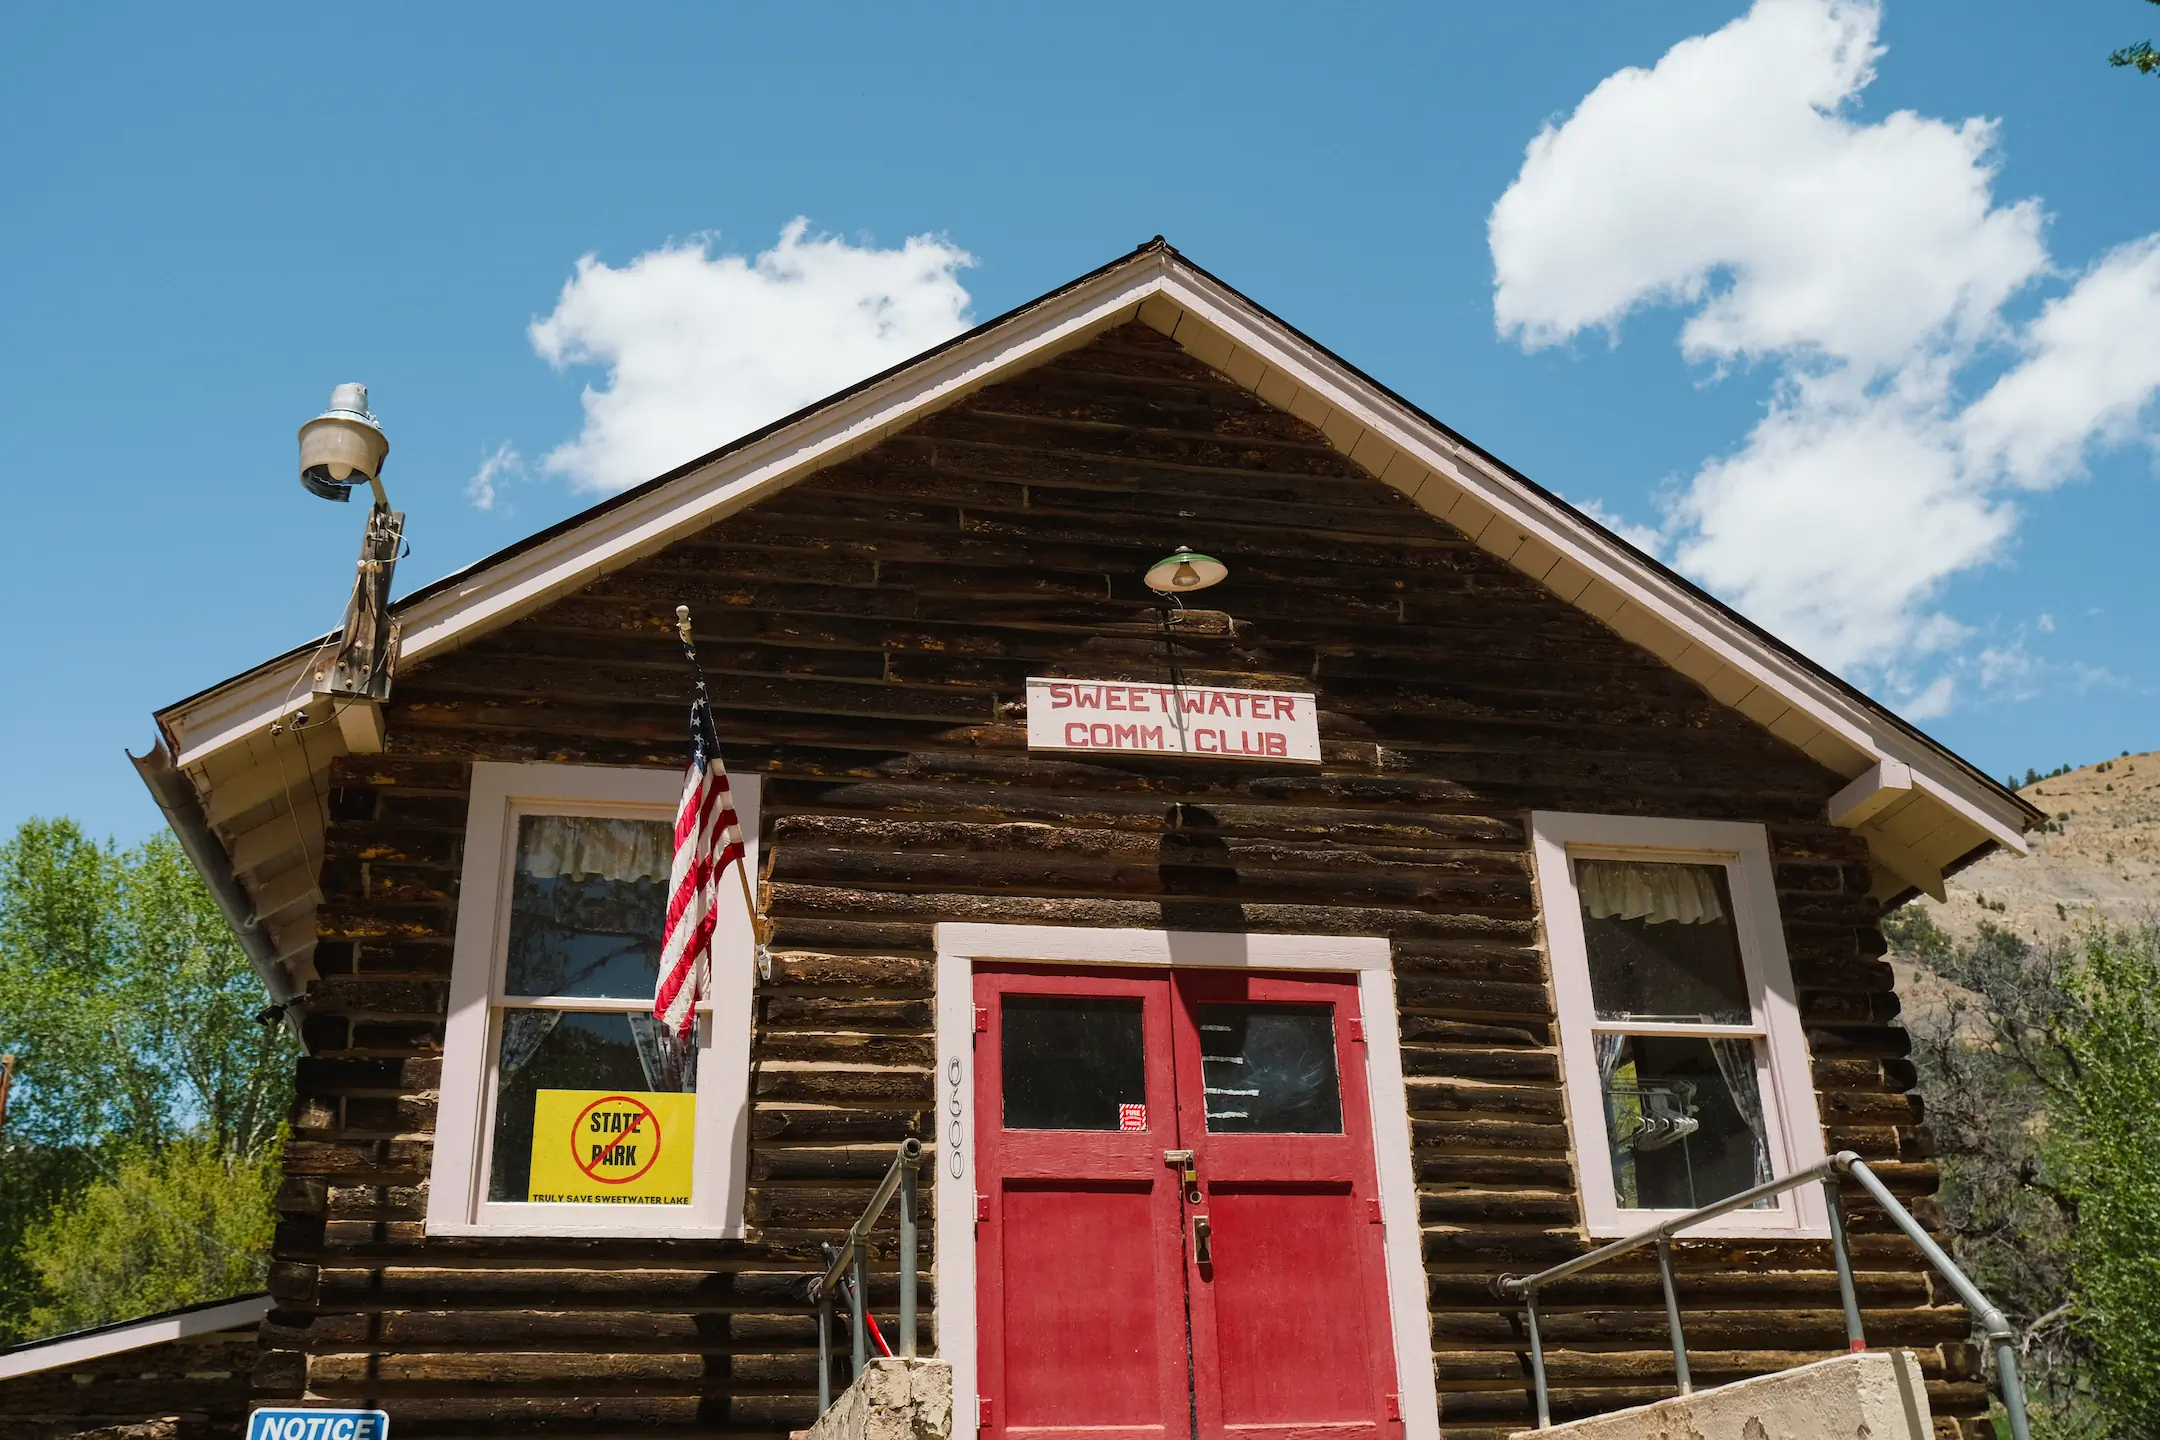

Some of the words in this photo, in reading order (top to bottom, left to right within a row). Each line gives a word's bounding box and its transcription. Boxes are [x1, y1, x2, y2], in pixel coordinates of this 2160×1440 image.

[1050, 683, 1295, 721] SWEETWATER
[1064, 722, 1175, 748] COMM.
[1194, 728, 1287, 757] CLUB
[590, 1112, 641, 1133] STATE
[1125, 1109, 1141, 1117] FIRE
[591, 1144, 637, 1166] PARK
[533, 1194, 564, 1203] TRULY
[566, 1195, 593, 1203] SAVE
[595, 1195, 662, 1204] SWEETWATER
[664, 1197, 689, 1205] LAKE
[260, 1417, 375, 1440] NOTICE
